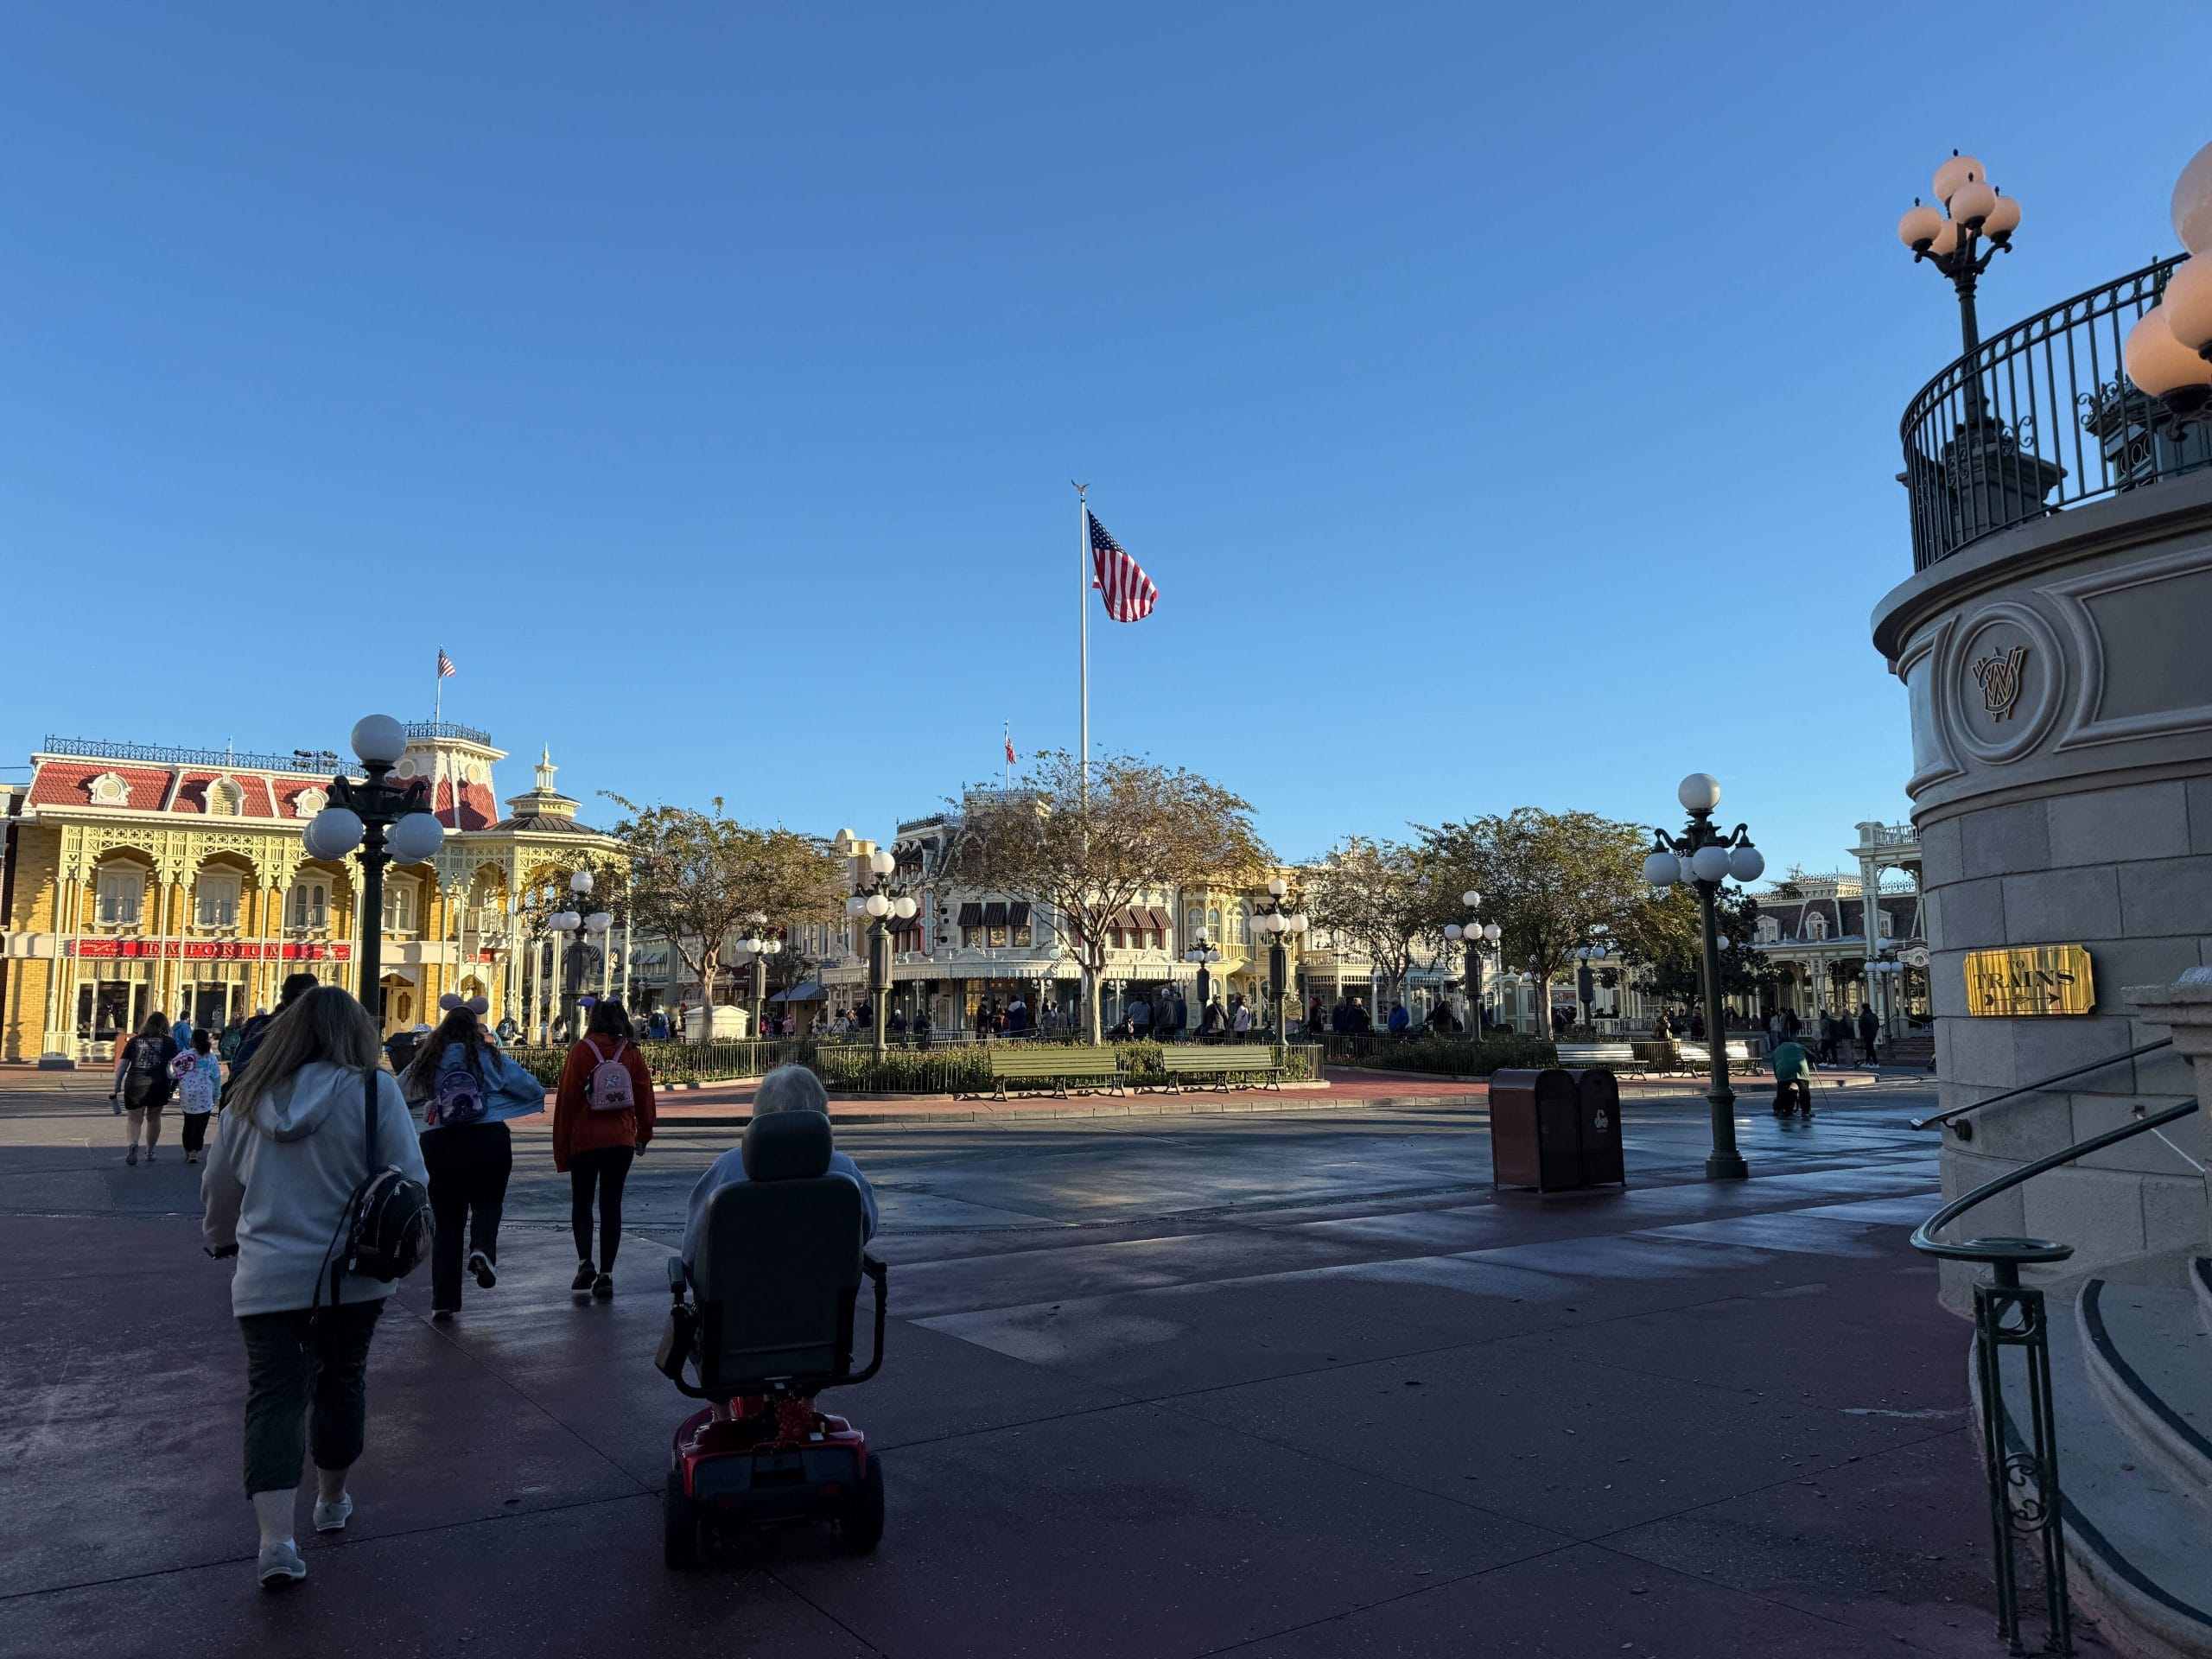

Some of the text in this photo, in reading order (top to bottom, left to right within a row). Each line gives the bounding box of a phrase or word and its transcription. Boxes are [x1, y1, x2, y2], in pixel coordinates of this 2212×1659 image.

[147, 944, 279, 957] EMPORIUM
[2007, 960, 2024, 969] TO
[1974, 969, 2075, 989] TRAINS
